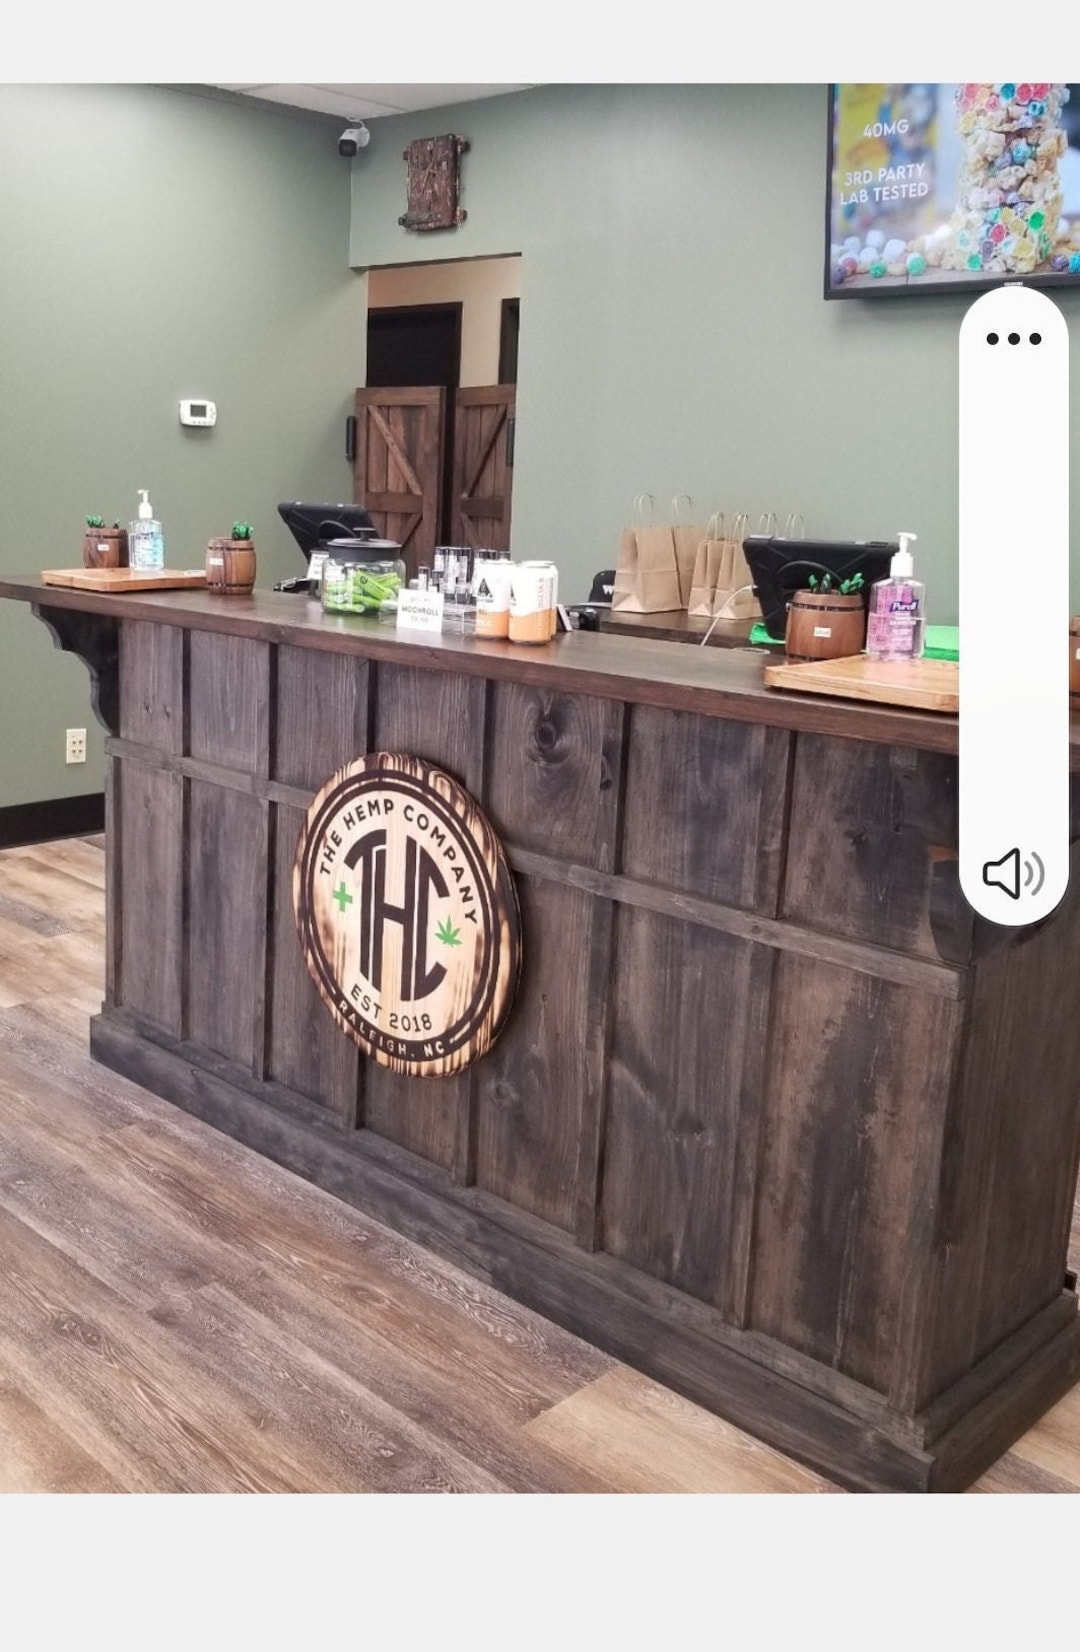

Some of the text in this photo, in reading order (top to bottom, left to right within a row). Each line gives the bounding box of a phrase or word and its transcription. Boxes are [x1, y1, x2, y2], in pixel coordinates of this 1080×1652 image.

[863, 119, 910, 138] 40MG
[844, 162, 926, 187] 3RD PARTY
[840, 182, 929, 206] LAB TESTED
[319, 798, 478, 925] THE HEMP COMPANY
[343, 828, 450, 1002] THC
[350, 983, 433, 1033] EST 2018
[423, 1041, 445, 1058] NC
